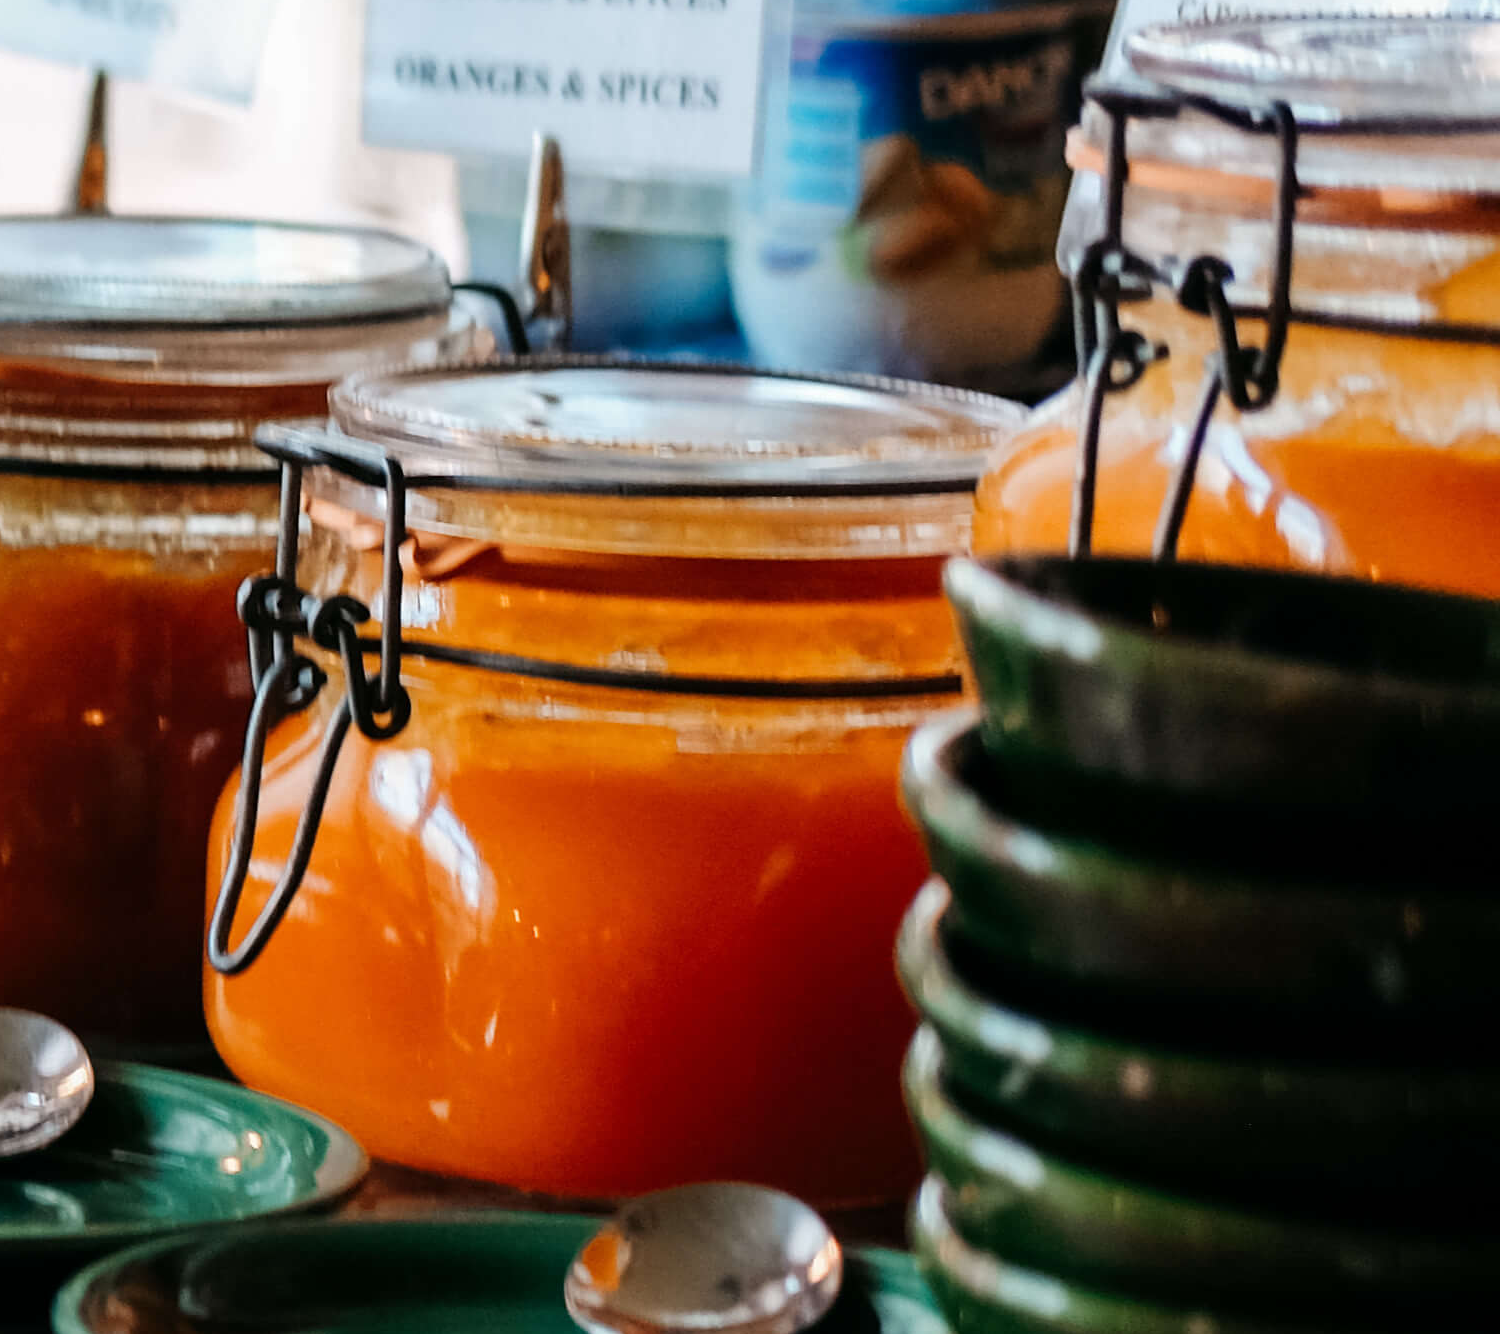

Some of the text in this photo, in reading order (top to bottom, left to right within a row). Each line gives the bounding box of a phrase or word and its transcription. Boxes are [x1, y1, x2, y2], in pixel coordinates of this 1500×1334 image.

[393, 55, 719, 109] ORANGES & SPICES
